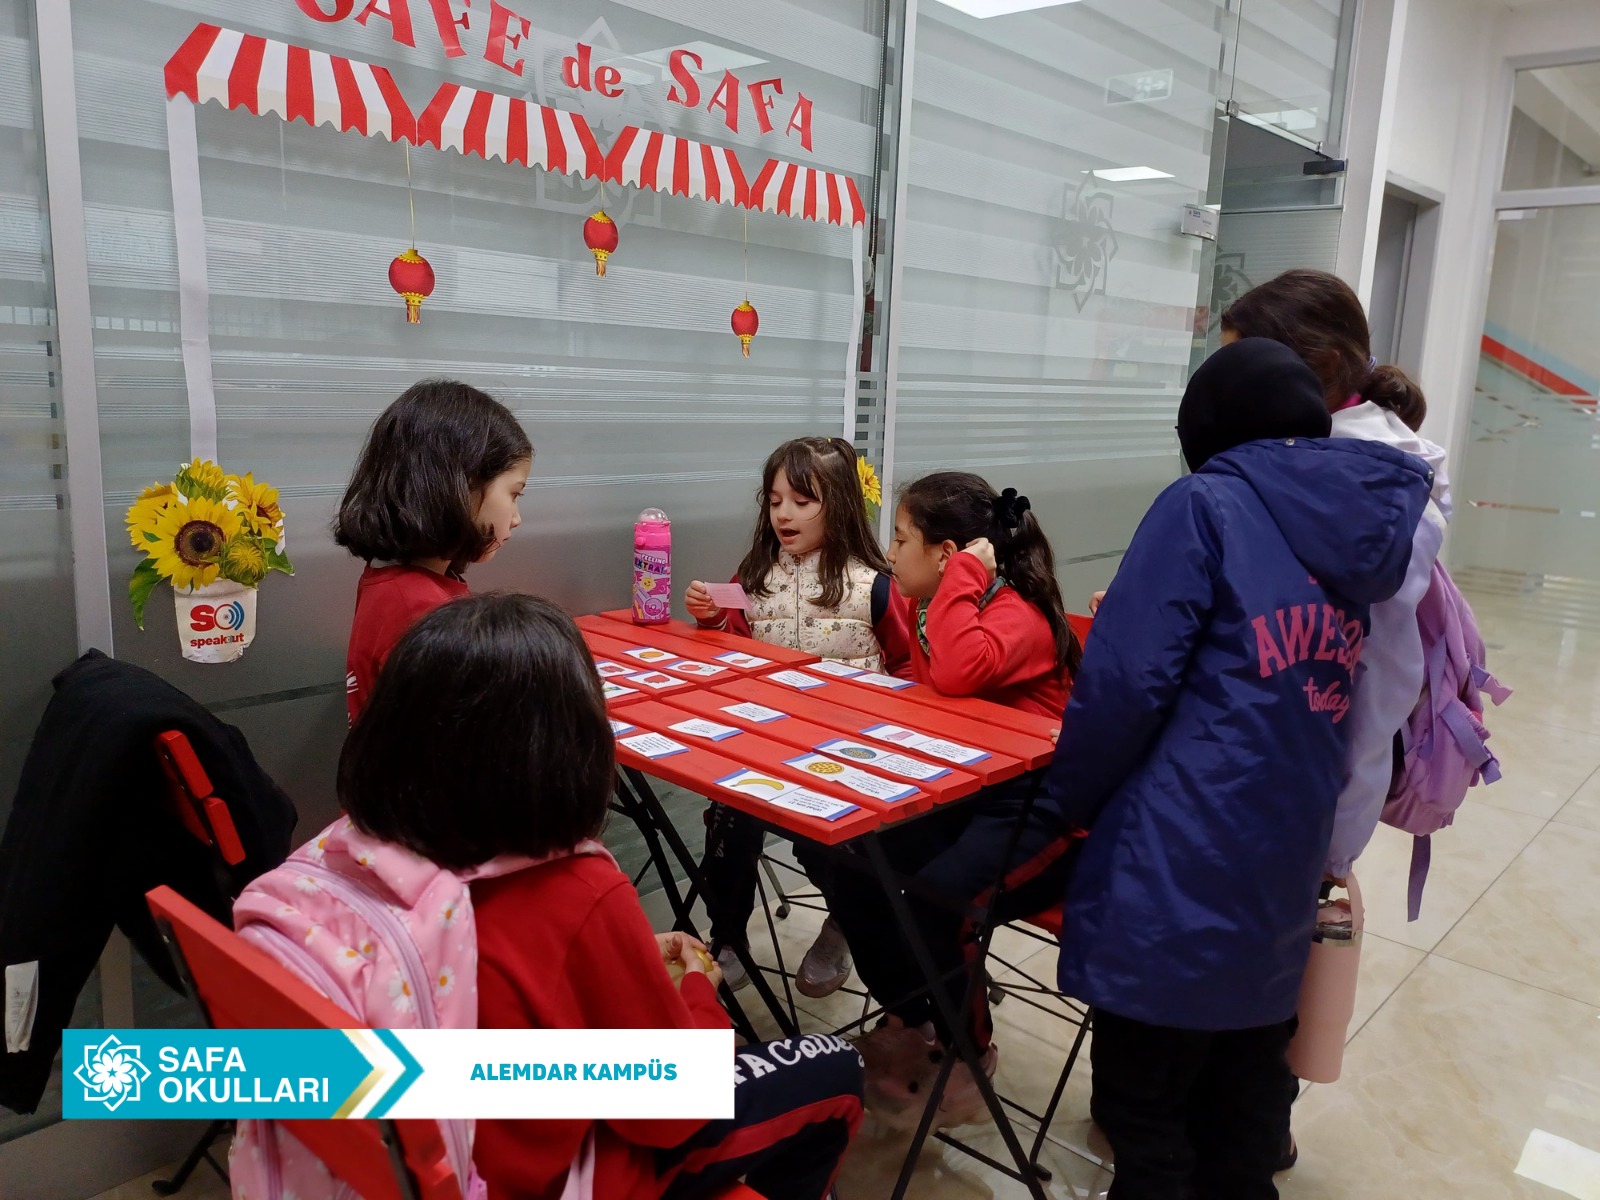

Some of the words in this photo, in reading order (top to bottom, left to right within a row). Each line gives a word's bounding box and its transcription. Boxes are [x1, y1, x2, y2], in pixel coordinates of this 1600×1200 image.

[562, 43, 624, 98] de
[666, 49, 815, 153] SAFA
[1302, 676, 1350, 724] today
